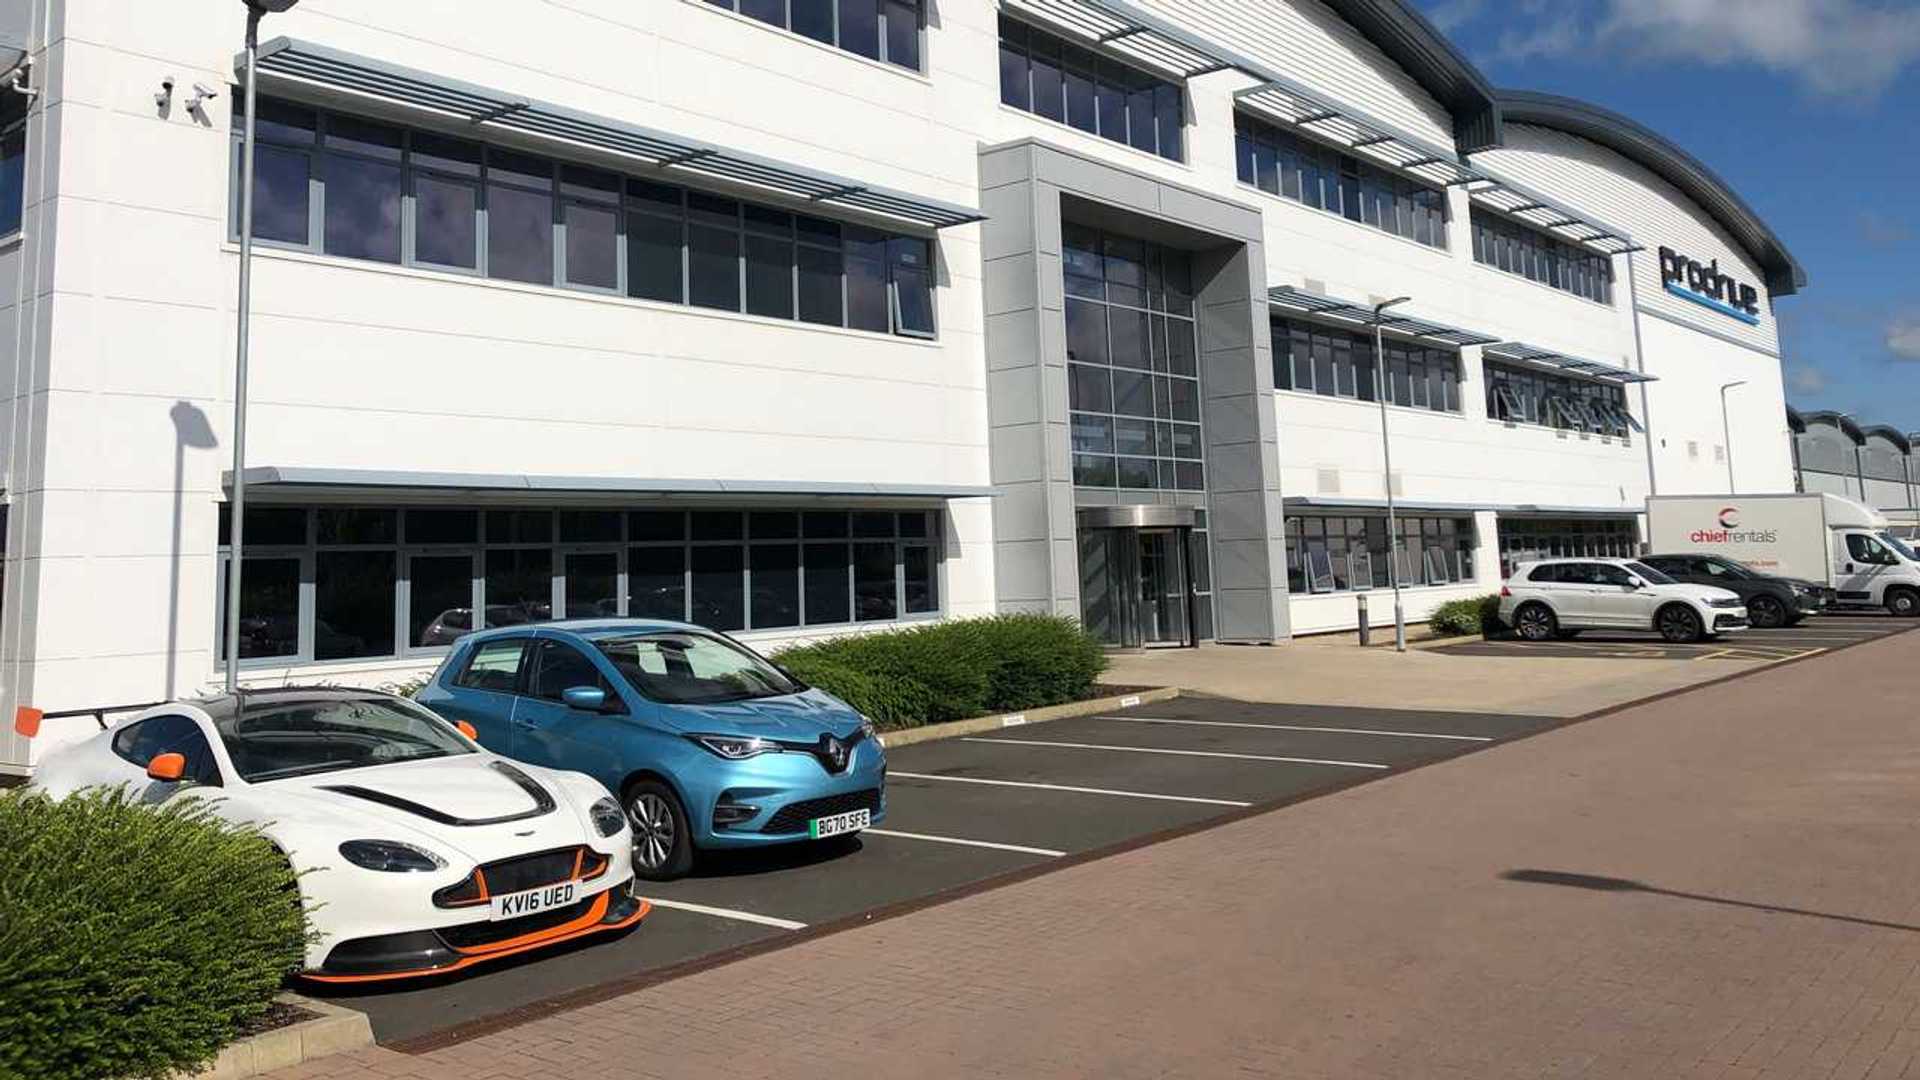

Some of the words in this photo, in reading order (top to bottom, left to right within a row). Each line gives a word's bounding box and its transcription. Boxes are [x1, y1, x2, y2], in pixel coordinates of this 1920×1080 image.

[819, 816, 846, 834] BG70
[849, 811, 868, 828] SFE
[502, 892, 539, 915] KV16
[544, 884, 574, 906] UED
